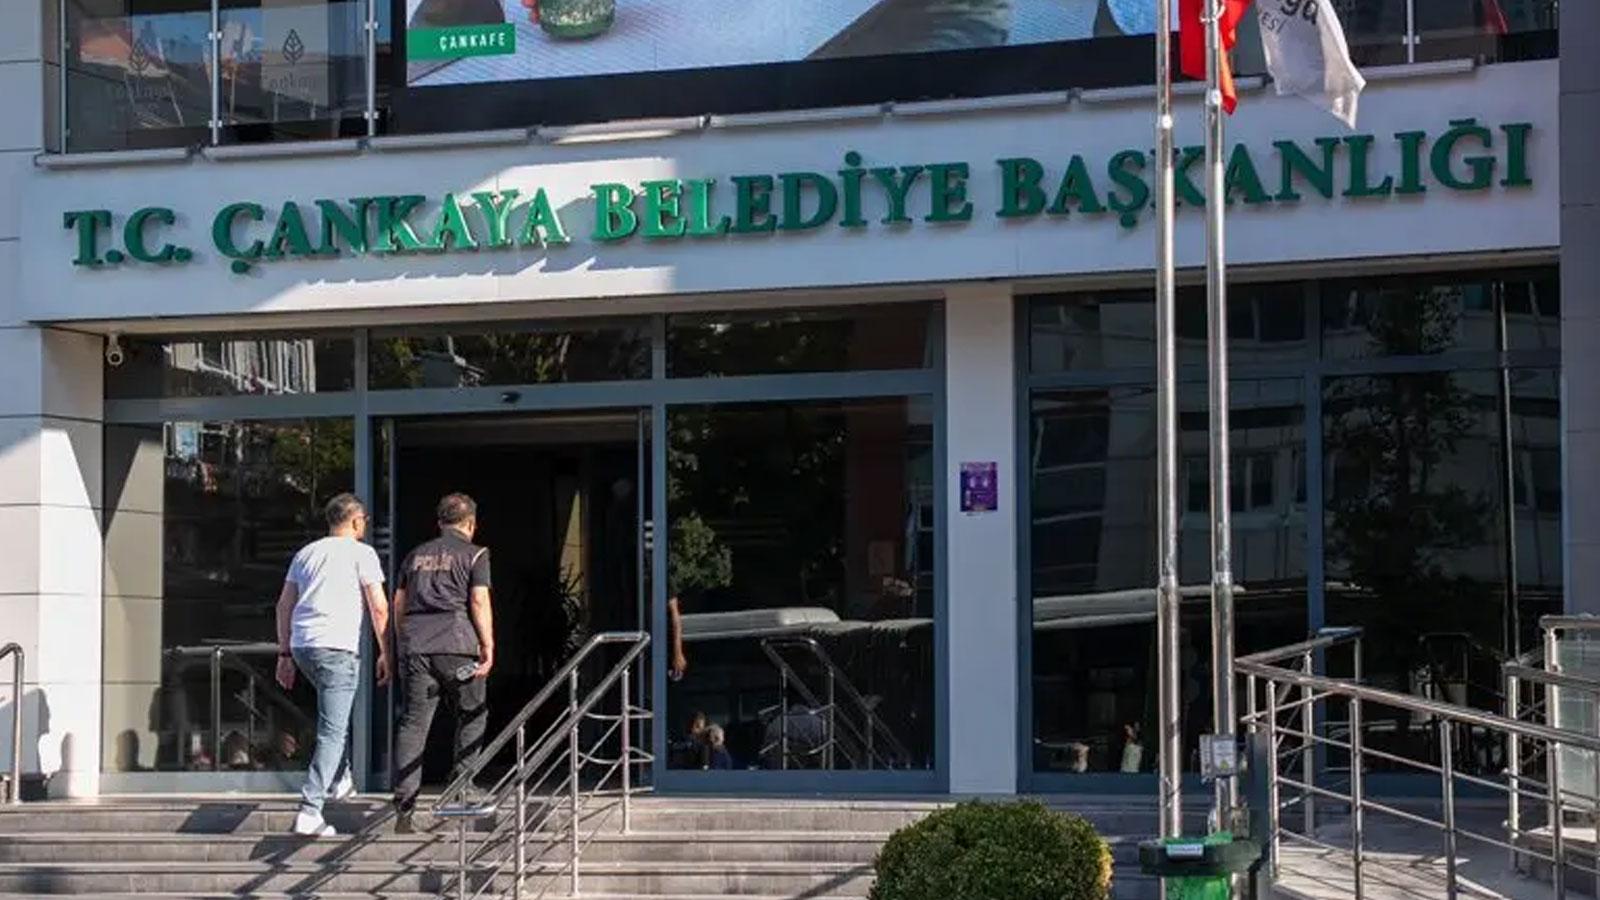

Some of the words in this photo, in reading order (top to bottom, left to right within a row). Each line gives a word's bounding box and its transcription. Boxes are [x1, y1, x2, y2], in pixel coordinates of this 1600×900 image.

[439, 33, 505, 51] ÇANKAFE
[64, 207, 192, 266] T.C.
[212, 187, 568, 274] ÇANKAYA
[591, 150, 973, 241] BELEDİYE
[996, 118, 1533, 228] BAŞKANLIĞI
